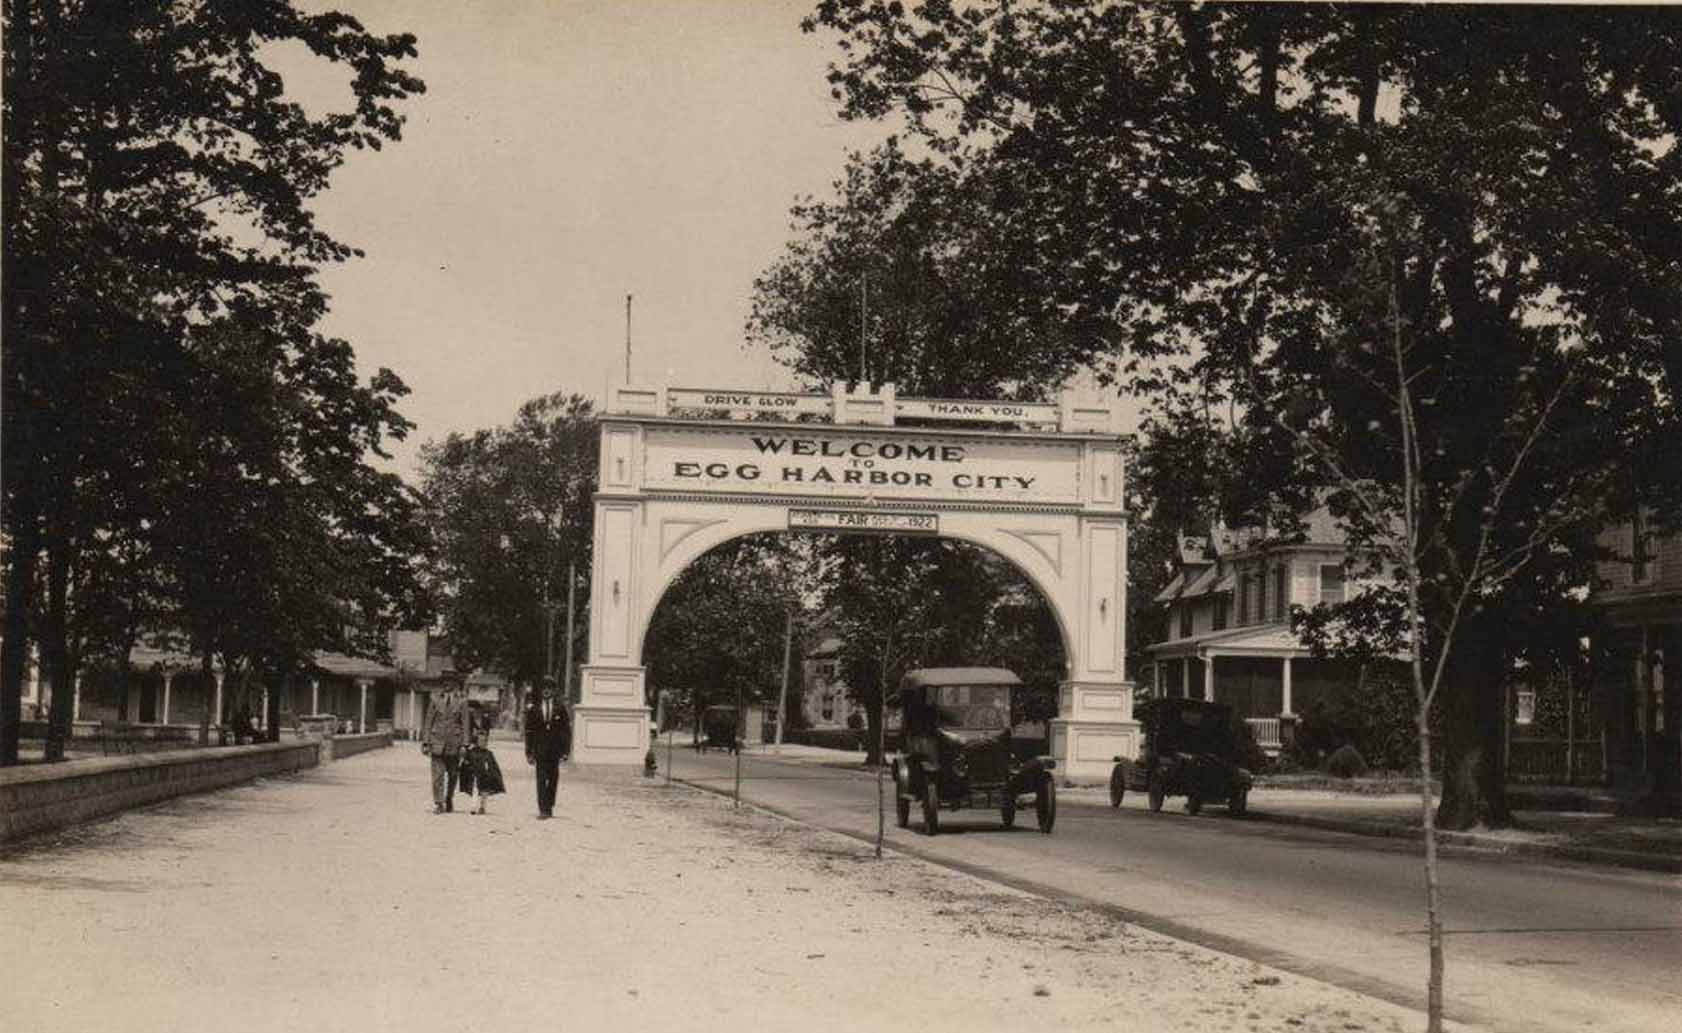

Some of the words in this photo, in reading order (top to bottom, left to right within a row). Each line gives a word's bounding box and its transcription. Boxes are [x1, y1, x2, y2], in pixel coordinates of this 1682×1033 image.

[705, 394, 751, 406] DRIVE
[928, 403, 984, 415] THANK
[752, 437, 966, 462] WELCOME
[851, 459, 875, 469] TO
[674, 462, 761, 480] EGG
[781, 466, 933, 487] HARBOR
[952, 474, 1036, 489] CITY
[839, 513, 869, 526] FAIR
